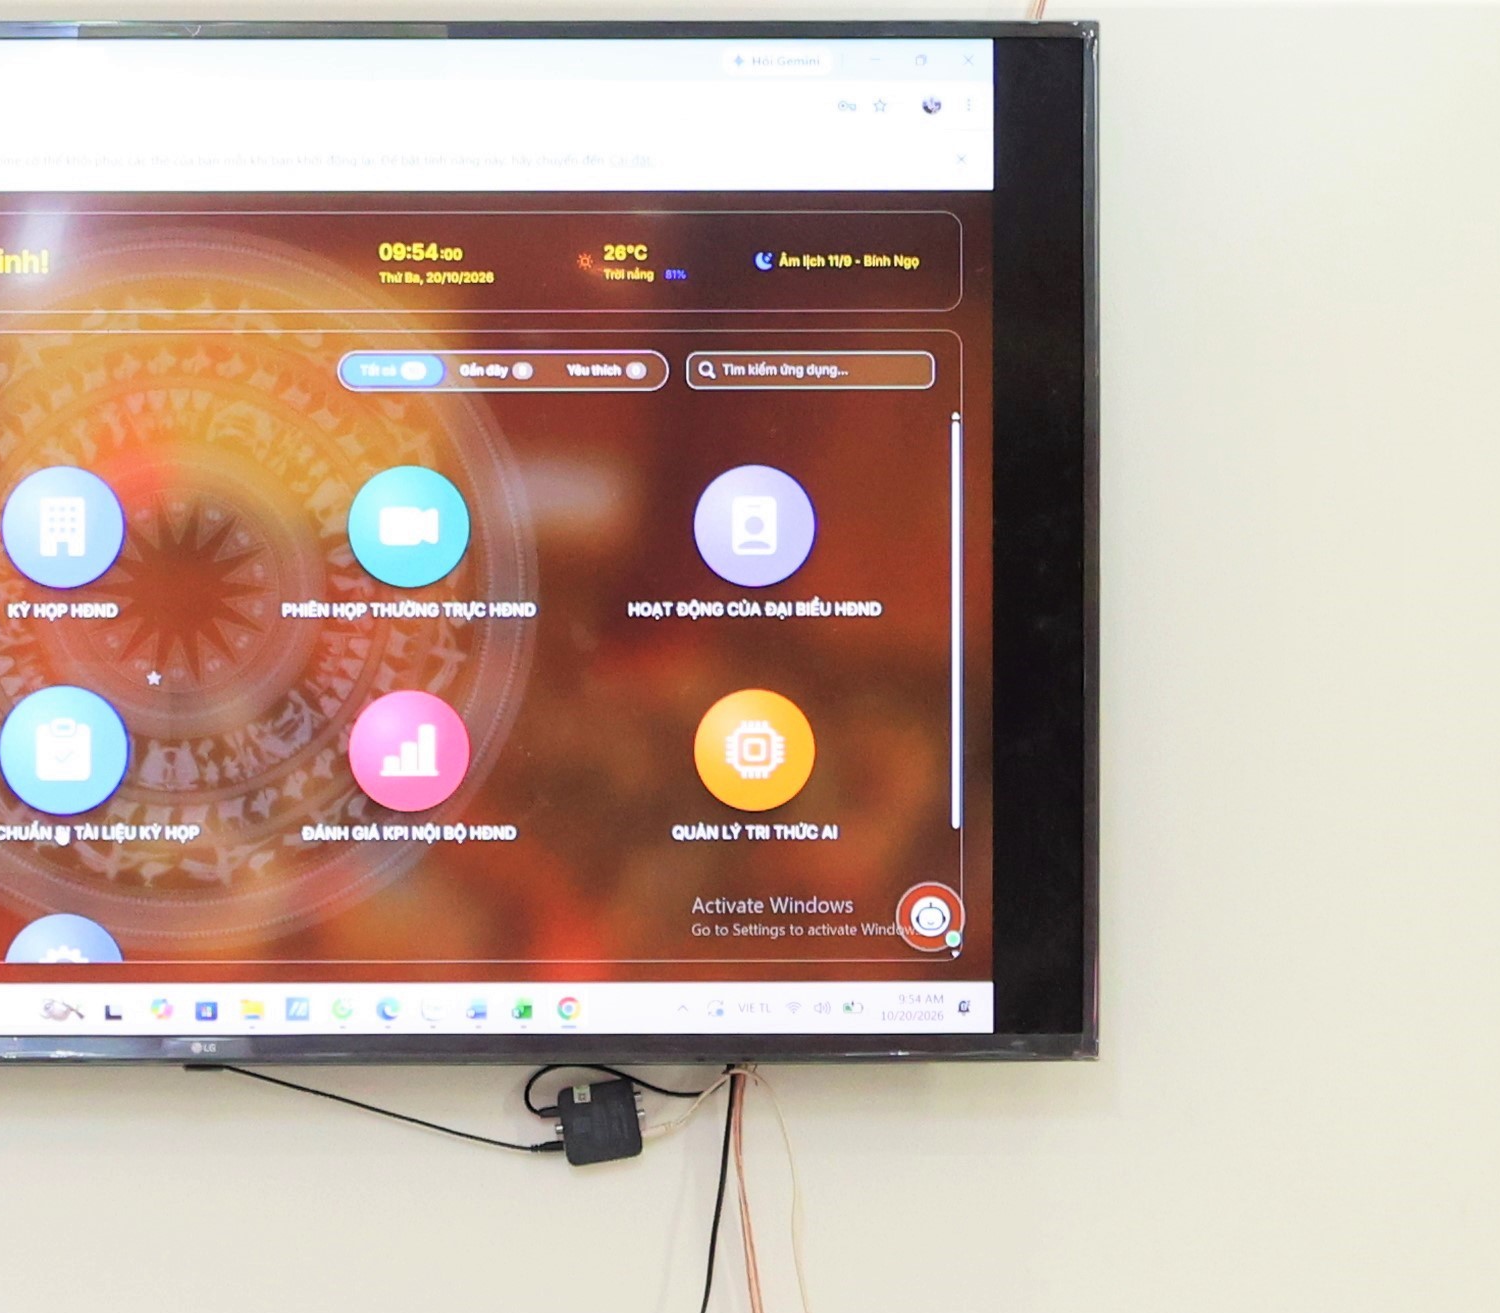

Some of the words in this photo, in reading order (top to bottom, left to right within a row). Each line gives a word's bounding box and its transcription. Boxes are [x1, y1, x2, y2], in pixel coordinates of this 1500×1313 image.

[776, 56, 821, 66] Gemini
[378, 242, 463, 261] 09:54:00
[778, 251, 801, 267] Âm
[802, 254, 826, 270] lịch
[863, 254, 892, 267] Bính
[893, 254, 920, 270] Ngọ
[425, 271, 495, 285] 20/10/2026
[722, 363, 746, 376] Tìm
[747, 361, 778, 376] kiếm
[7, 600, 31, 619] KỲ
[33, 602, 69, 622] HỌP
[70, 602, 119, 618] HĐND
[281, 599, 330, 618] PHIÊN
[332, 602, 368, 621] HỌP
[369, 599, 440, 618] THƯỜNG
[441, 601, 487, 621] TRỰC
[488, 601, 537, 618] HĐND
[627, 601, 674, 621] HOẠT
[675, 598, 725, 620] ĐỘNG
[726, 598, 762, 617] CỦA
[763, 601, 793, 620] ĐẠI
[795, 595, 832, 617] BIỂU
[834, 601, 883, 617] HĐND
[73, 822, 99, 841] TÀI
[101, 822, 137, 844] LIỆU
[139, 822, 163, 841] KỲ
[164, 824, 201, 844] HỌP
[301, 822, 350, 841] ĐÁNH
[351, 823, 381, 841] GIÁ
[382, 825, 409, 841] KPI
[411, 822, 441, 845] NỘI
[443, 822, 467, 844] BỘ
[469, 825, 517, 841] HĐND
[671, 821, 720, 841] QUẢN
[721, 822, 742, 840] LÝ
[744, 824, 771, 840] TRI
[773, 822, 819, 840] THỨC
[821, 824, 839, 840] AI
[691, 896, 765, 914] Activate
[769, 895, 854, 914] Windows
[691, 923, 711, 937] Go
[714, 924, 729, 937] to
[732, 923, 786, 940] Settings
[789, 923, 804, 936] to
[807, 923, 858, 936] activate
[861, 922, 921, 937] Window
[898, 994, 922, 1005] 9:54
[926, 994, 944, 1005] AM
[881, 1010, 945, 1022] 10/20/2026
[203, 1043, 217, 1053] LG
